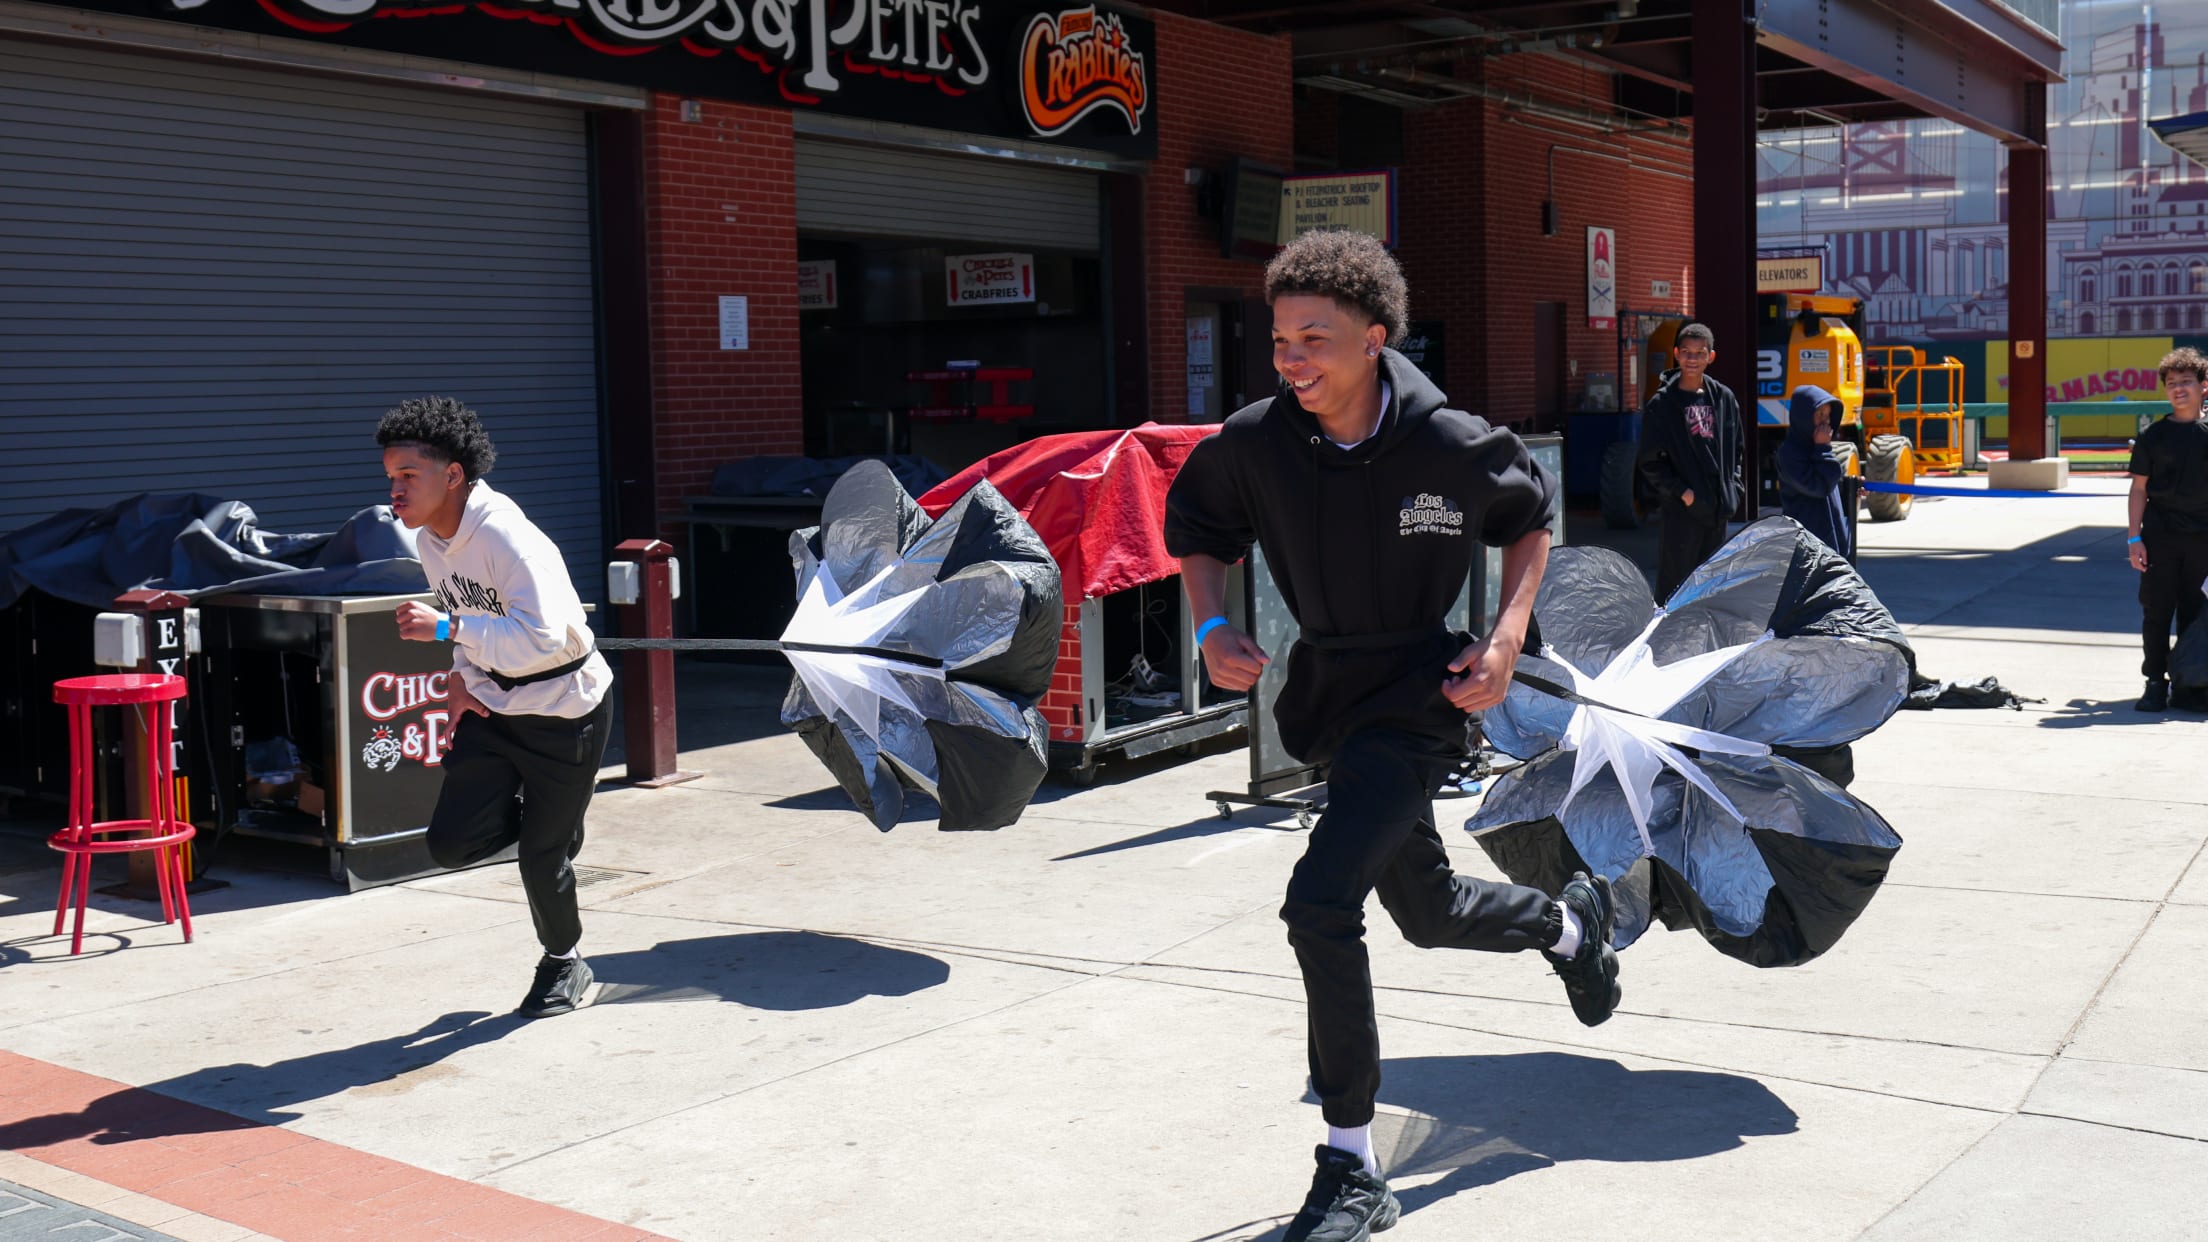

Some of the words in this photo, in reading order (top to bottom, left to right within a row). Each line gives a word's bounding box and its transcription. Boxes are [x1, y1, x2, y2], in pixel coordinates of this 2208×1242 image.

[1350, 182, 1381, 194] ROOFTOP
[1343, 195, 1371, 206] SEATING
[1759, 268, 1809, 280] ELEVATORS
[961, 287, 1019, 300] CRABFRIES
[1414, 493, 1443, 508] Los
[1400, 507, 1463, 527] Angeles
